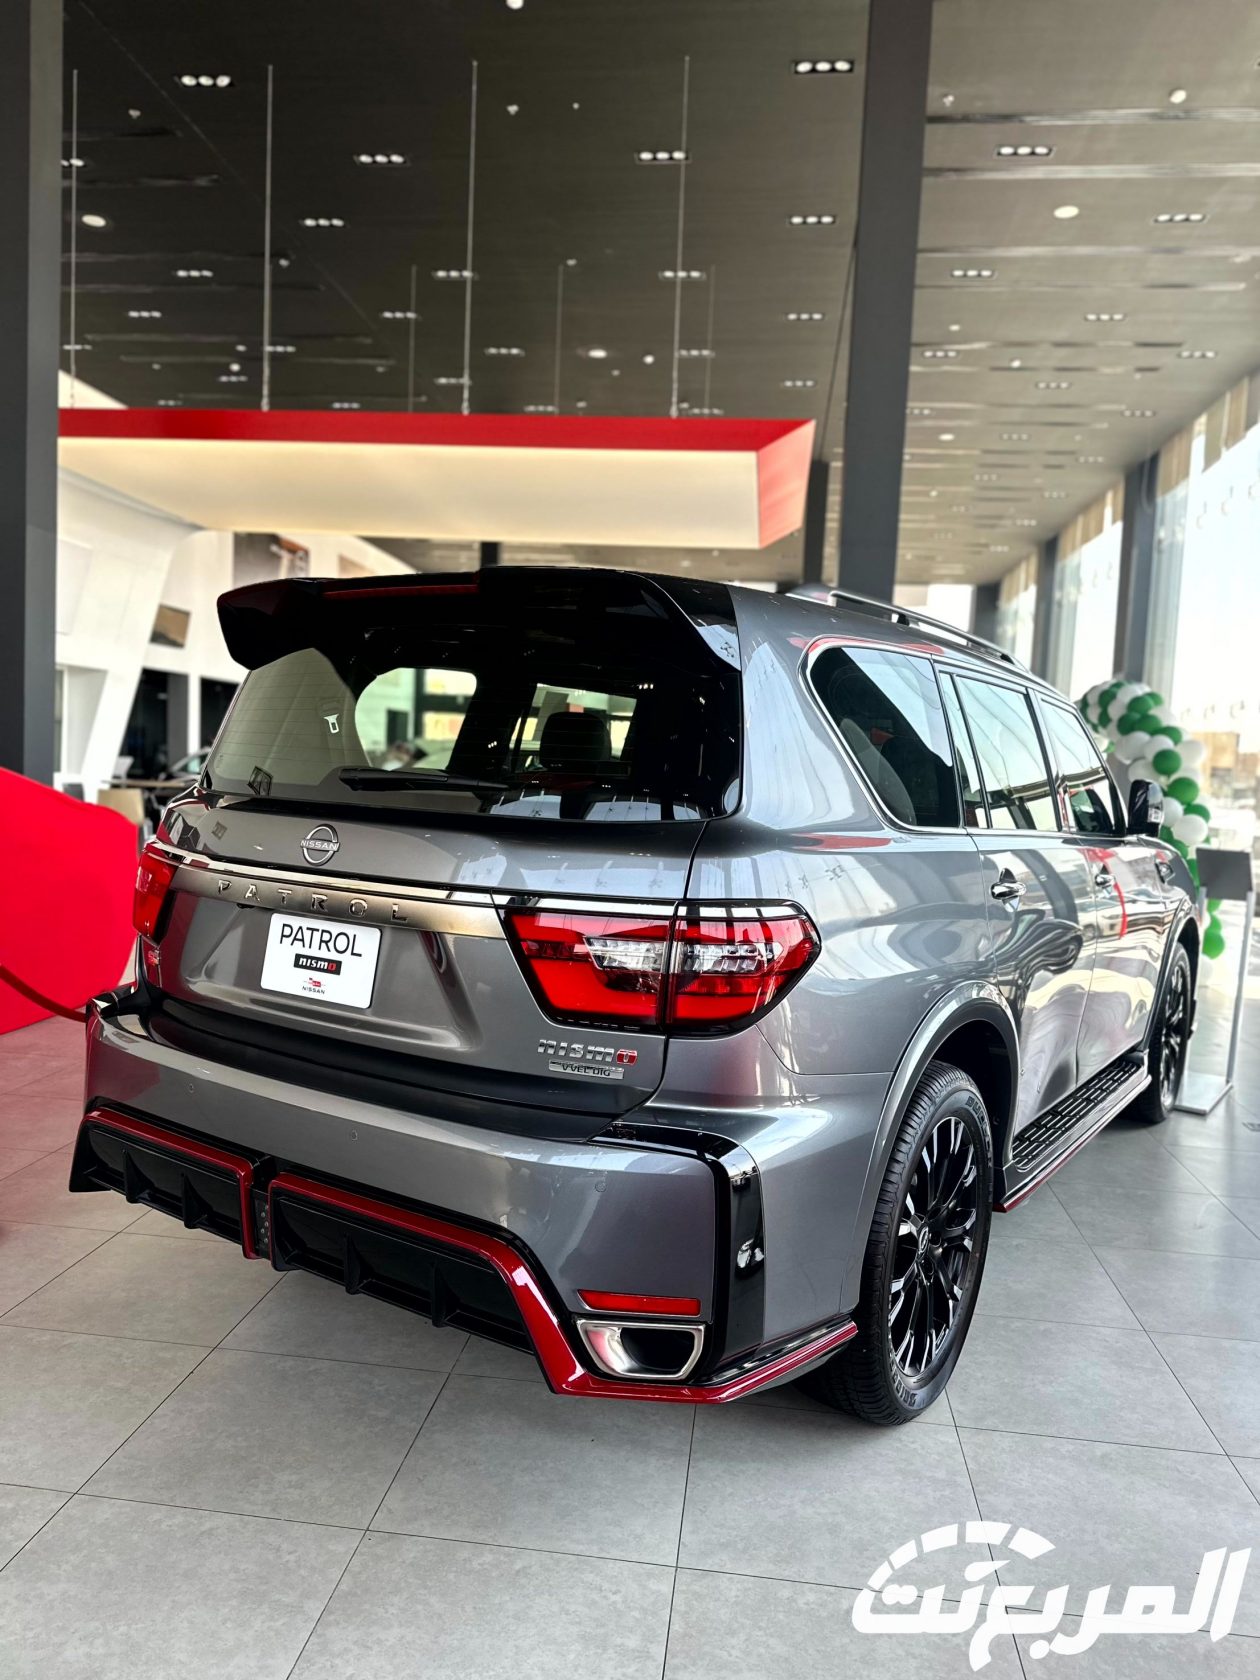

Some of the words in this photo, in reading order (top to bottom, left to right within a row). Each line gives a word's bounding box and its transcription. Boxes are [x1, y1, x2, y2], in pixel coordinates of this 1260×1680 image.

[300, 839, 340, 851] NISSAN
[217, 879, 408, 922] PATROL
[279, 923, 362, 957] PATROL
[301, 985, 326, 995] NISSAN
